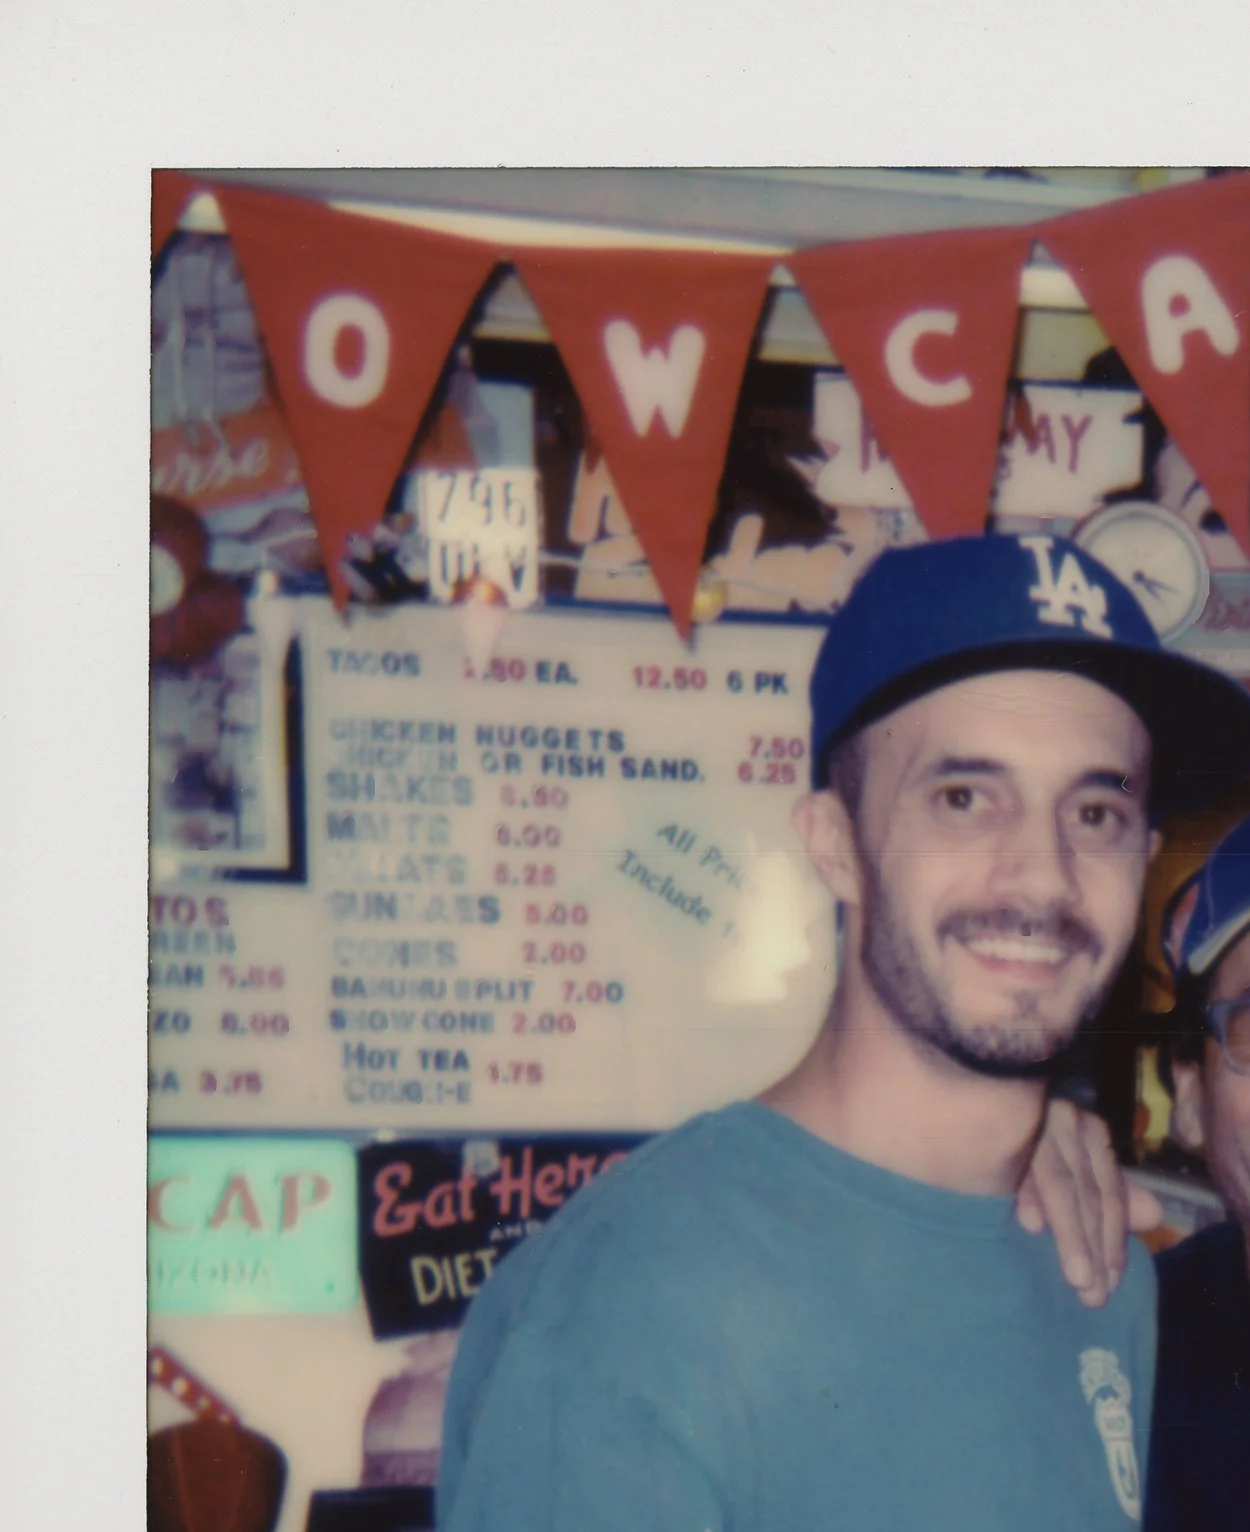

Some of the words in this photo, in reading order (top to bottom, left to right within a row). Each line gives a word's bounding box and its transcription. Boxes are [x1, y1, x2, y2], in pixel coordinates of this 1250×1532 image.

[1018, 536, 1114, 638] LA
[535, 660, 578, 685] EA.
[633, 665, 708, 691] 12.50
[726, 669, 743, 693] 6
[754, 671, 788, 695] PK
[475, 723, 625, 753] NUGGETS
[749, 736, 805, 760] 7.50
[481, 751, 523, 775] OR
[541, 753, 605, 778] FISH
[620, 756, 705, 782] SAND.
[656, 824, 699, 855] All
[617, 848, 712, 925] Include
[562, 980, 625, 1005] 7.00
[421, 1009, 495, 1035] CONE
[511, 1011, 577, 1035] 2.00
[417, 1048, 471, 1072] TEA
[148, 1173, 333, 1233] CAP
[374, 1161, 477, 1239] Eat
